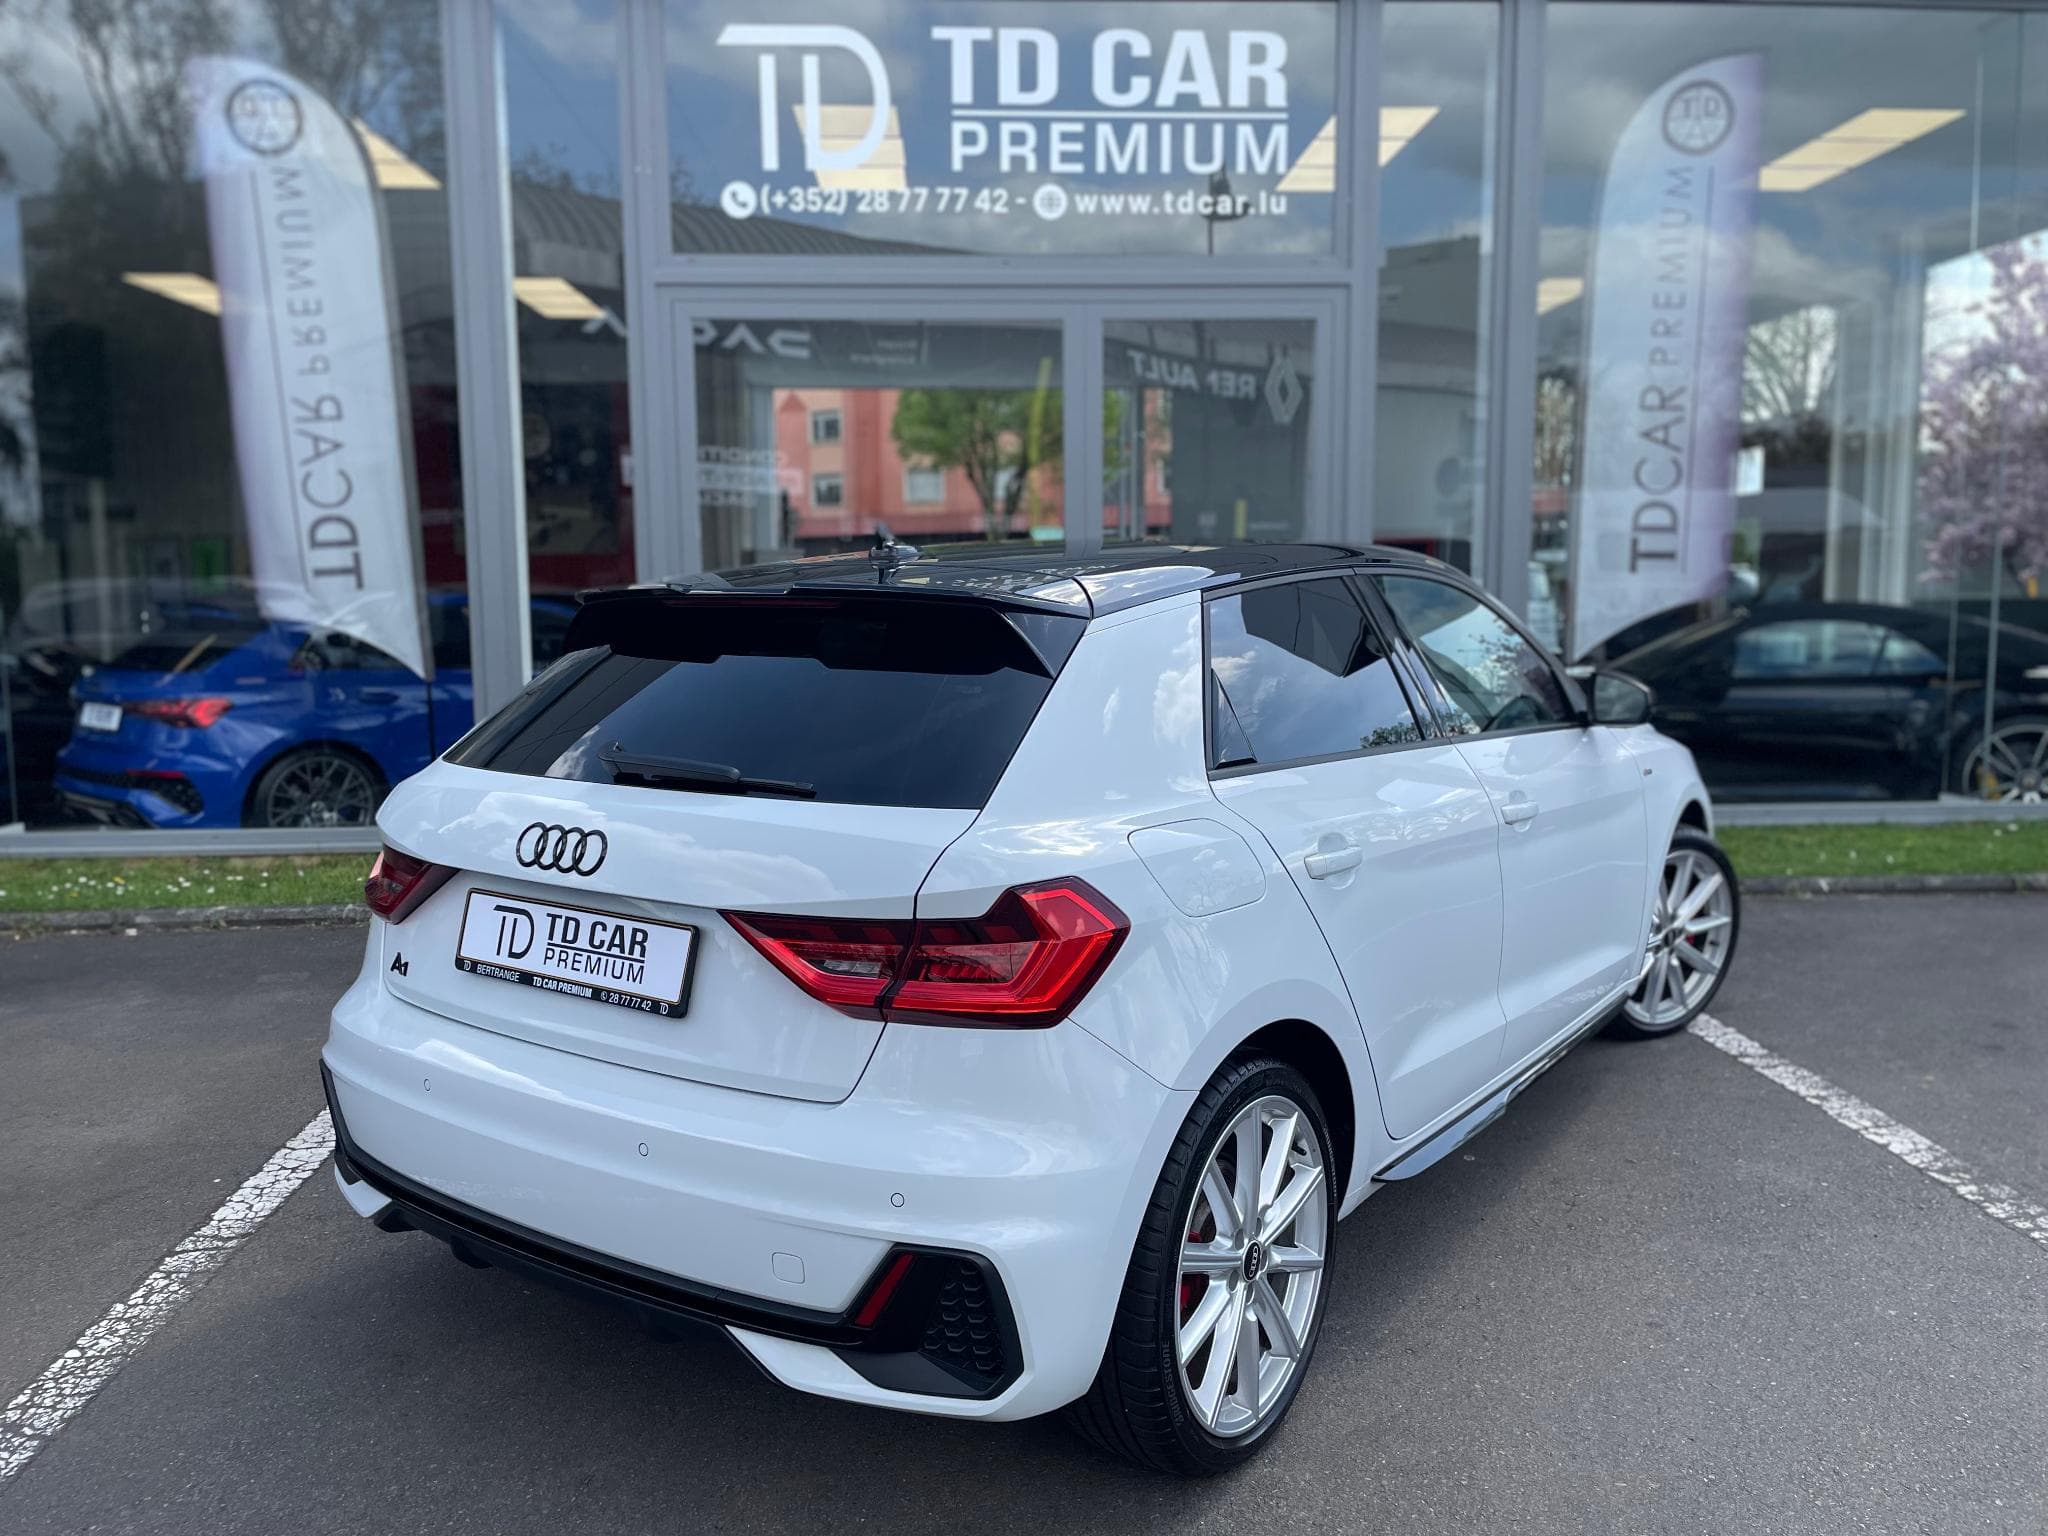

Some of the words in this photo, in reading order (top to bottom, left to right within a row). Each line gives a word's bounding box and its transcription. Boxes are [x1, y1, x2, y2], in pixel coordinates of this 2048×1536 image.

[931, 27, 1060, 105] TD
[1092, 29, 1288, 108] CAR
[951, 121, 1288, 174] PREMIUM
[760, 184, 847, 215] (+352)
[856, 189, 891, 214] 28
[897, 187, 930, 214] 77
[935, 187, 969, 214] 77
[974, 188, 1010, 214] 42
[1075, 189, 1288, 217] www.tdcar.lu
[1650, 166, 1694, 367] PREMIUM
[546, 912, 581, 945] TD
[589, 921, 649, 958] CAR
[390, 951, 409, 977] A1
[476, 963, 520, 982] BERTRANGE
[532, 976, 542, 987] TD
[543, 978, 558, 991] CAR
[558, 981, 593, 998] PREMIUM
[608, 992, 619, 1004] 28
[620, 994, 630, 1006] 77
[631, 996, 641, 1008] 77
[641, 1000, 652, 1011] 42
[544, 948, 645, 985] PREMIUM
